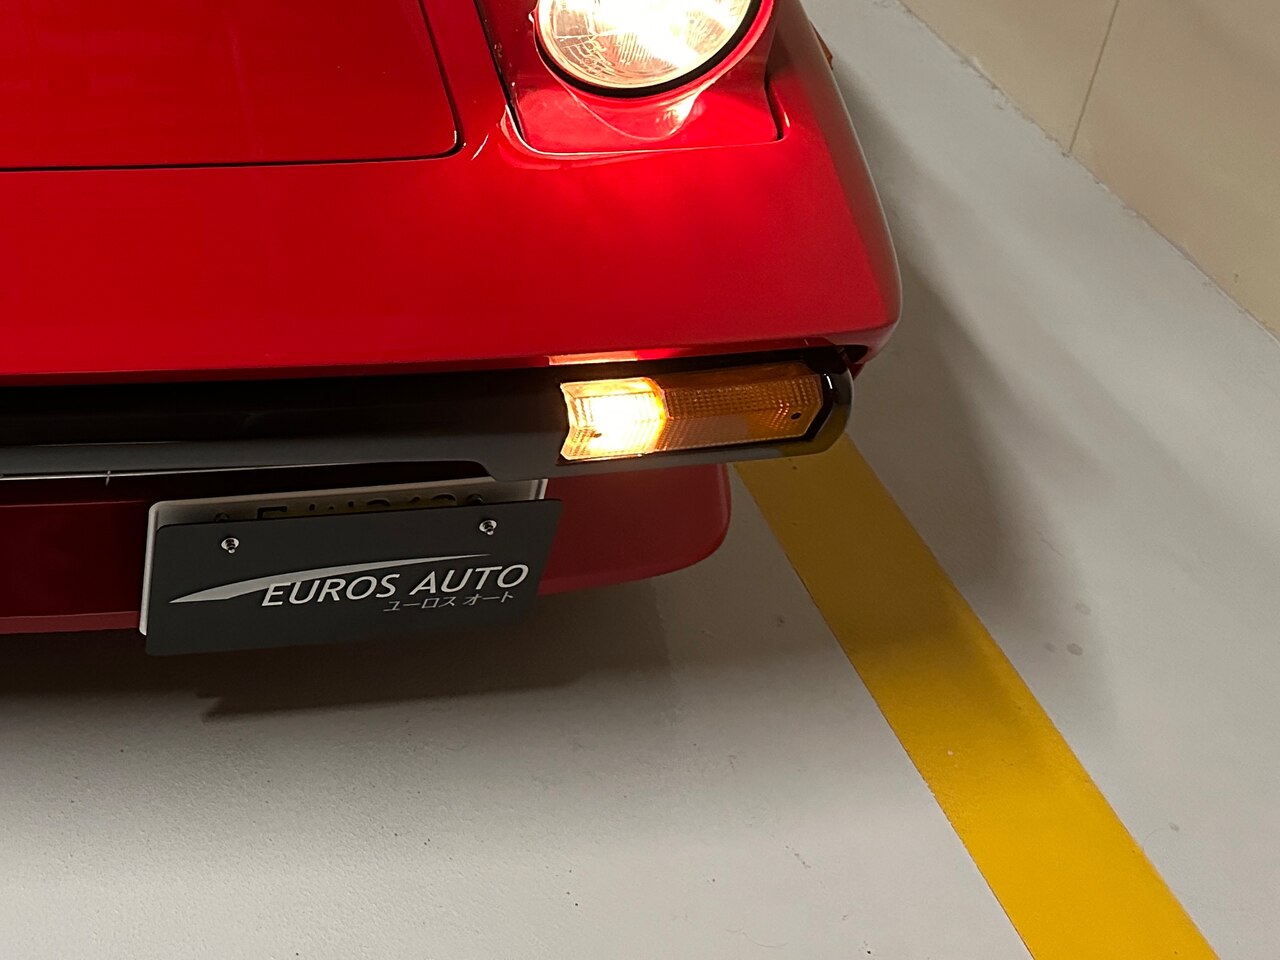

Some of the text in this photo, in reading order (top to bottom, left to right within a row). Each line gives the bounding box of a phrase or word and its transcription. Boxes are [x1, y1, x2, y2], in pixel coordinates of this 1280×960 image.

[261, 564, 529, 607] EUROS AUTO
[383, 591, 515, 612] ユーロス オート
